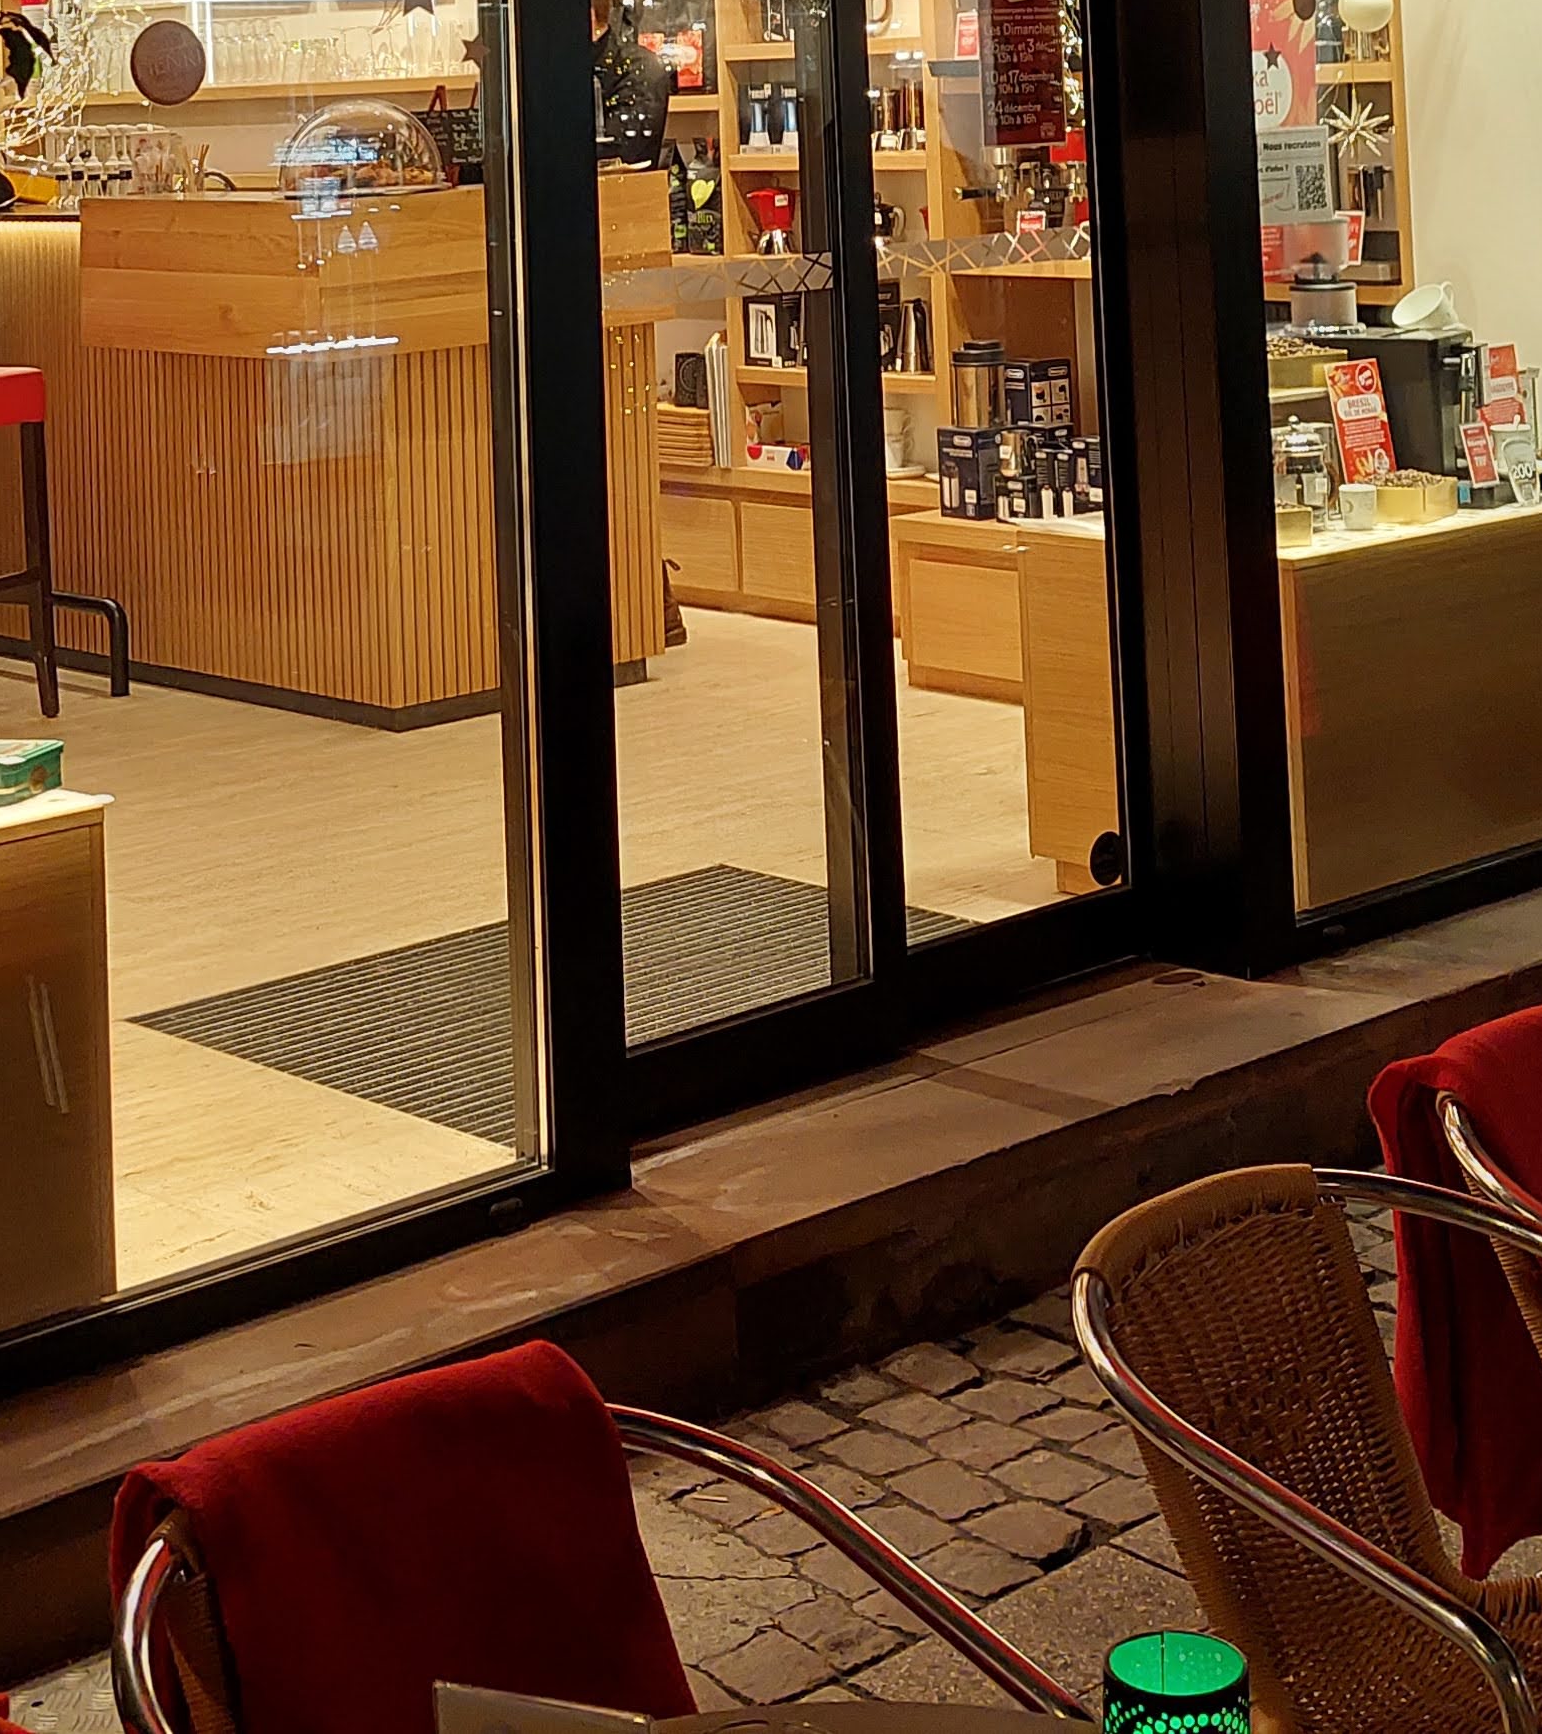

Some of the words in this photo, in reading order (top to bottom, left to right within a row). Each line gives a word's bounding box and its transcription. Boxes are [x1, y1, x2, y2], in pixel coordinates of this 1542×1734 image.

[987, 100, 1003, 116] 24
[1263, 143, 1282, 151] Nous
[1284, 140, 1321, 150] recrutons
